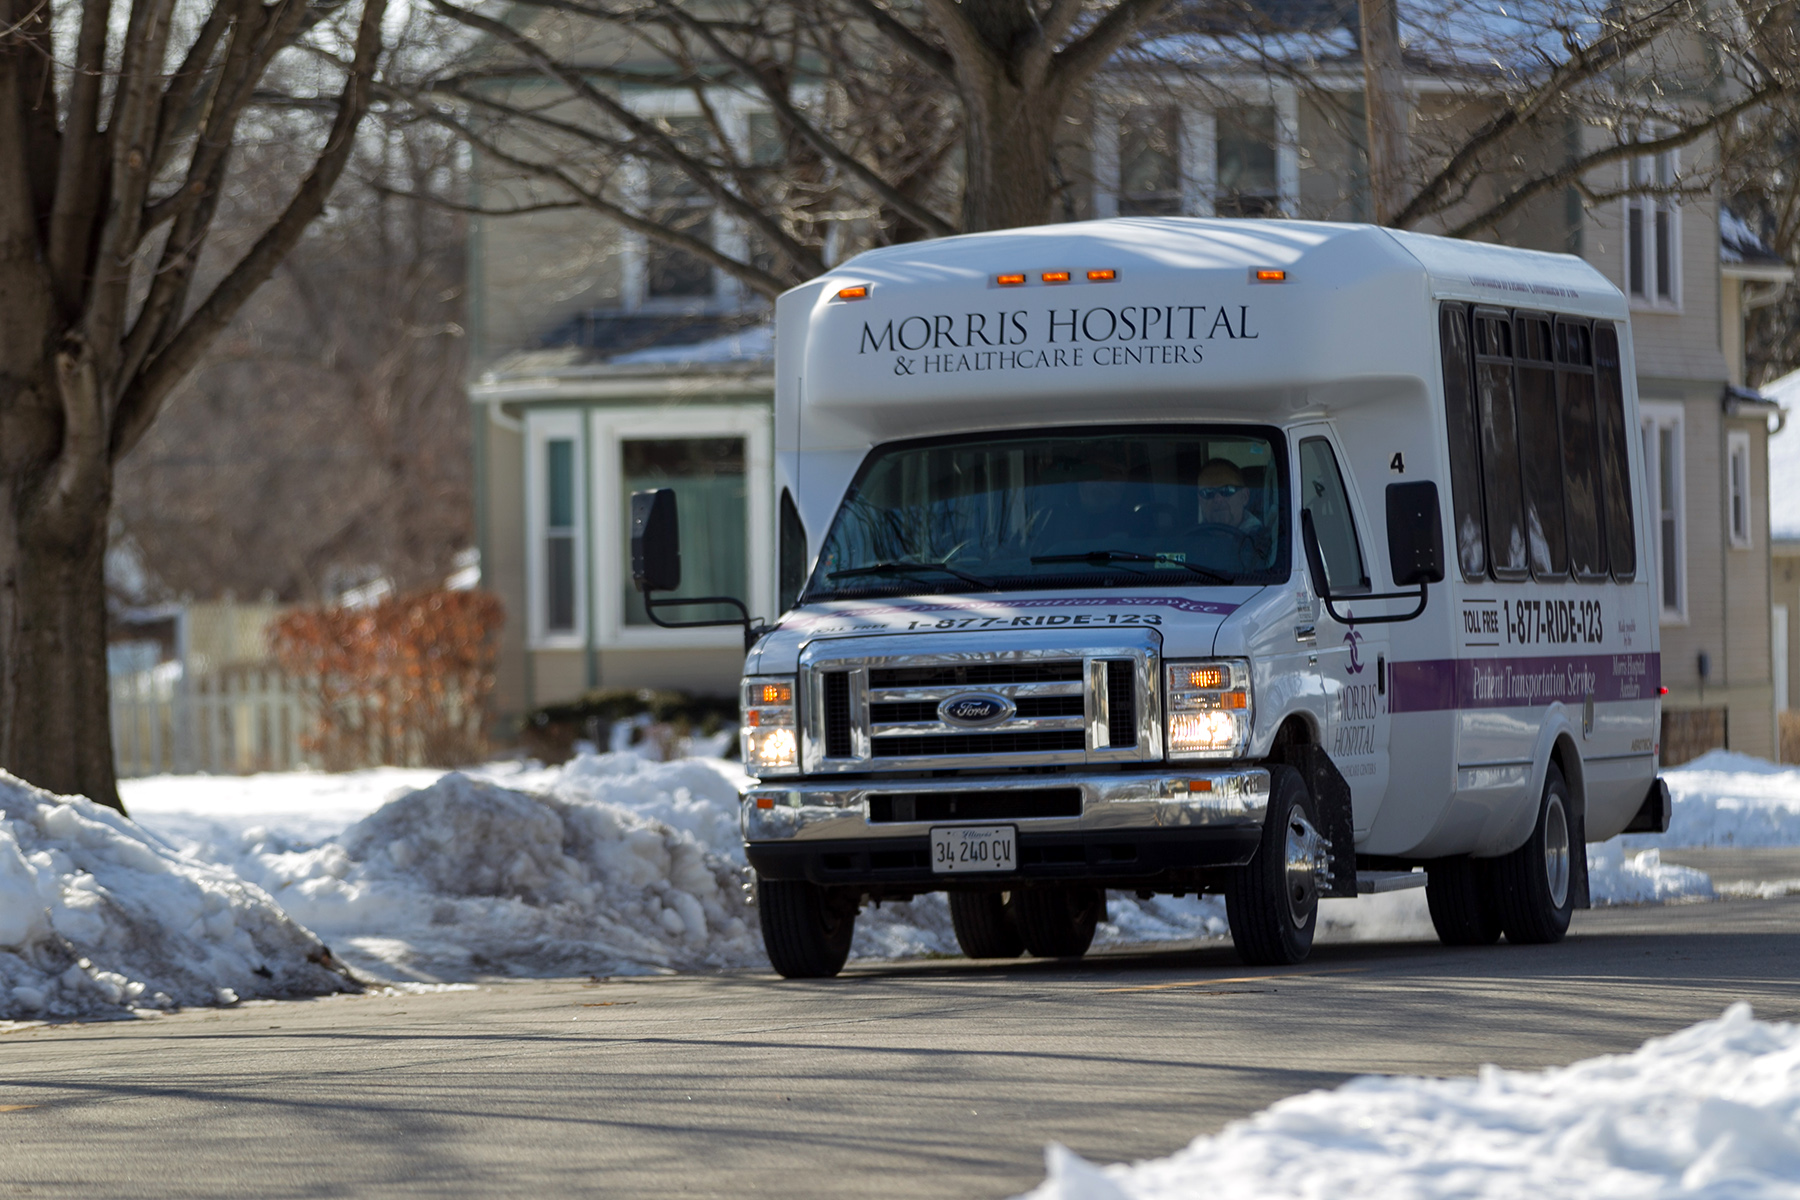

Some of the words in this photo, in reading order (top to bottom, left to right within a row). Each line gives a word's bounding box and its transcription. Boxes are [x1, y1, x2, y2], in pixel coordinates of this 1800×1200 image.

[858, 310, 1029, 355] MORRIS
[1047, 305, 1260, 345] HOSPITAL
[894, 355, 916, 377] &
[924, 348, 1084, 374] HEALTHCARE
[1093, 345, 1204, 367] CENTERS
[1390, 452, 1405, 474] 4
[1116, 597, 1219, 612] Service
[907, 614, 1163, 630] 1-877-RIDE-123
[1463, 610, 1481, 634] TOLL
[1482, 609, 1499, 633] FREE
[1503, 599, 1604, 644] 1-877-RIDE-123
[1473, 667, 1503, 700] Patient
[1506, 664, 1565, 706] Transportation
[1568, 662, 1596, 696] Service
[957, 701, 991, 717] Ford
[1337, 684, 1377, 723] MORRIS
[1333, 724, 1375, 757] HOSPITAL
[936, 841, 955, 863] 34
[960, 840, 988, 862] 240
[992, 839, 1011, 862] CV
